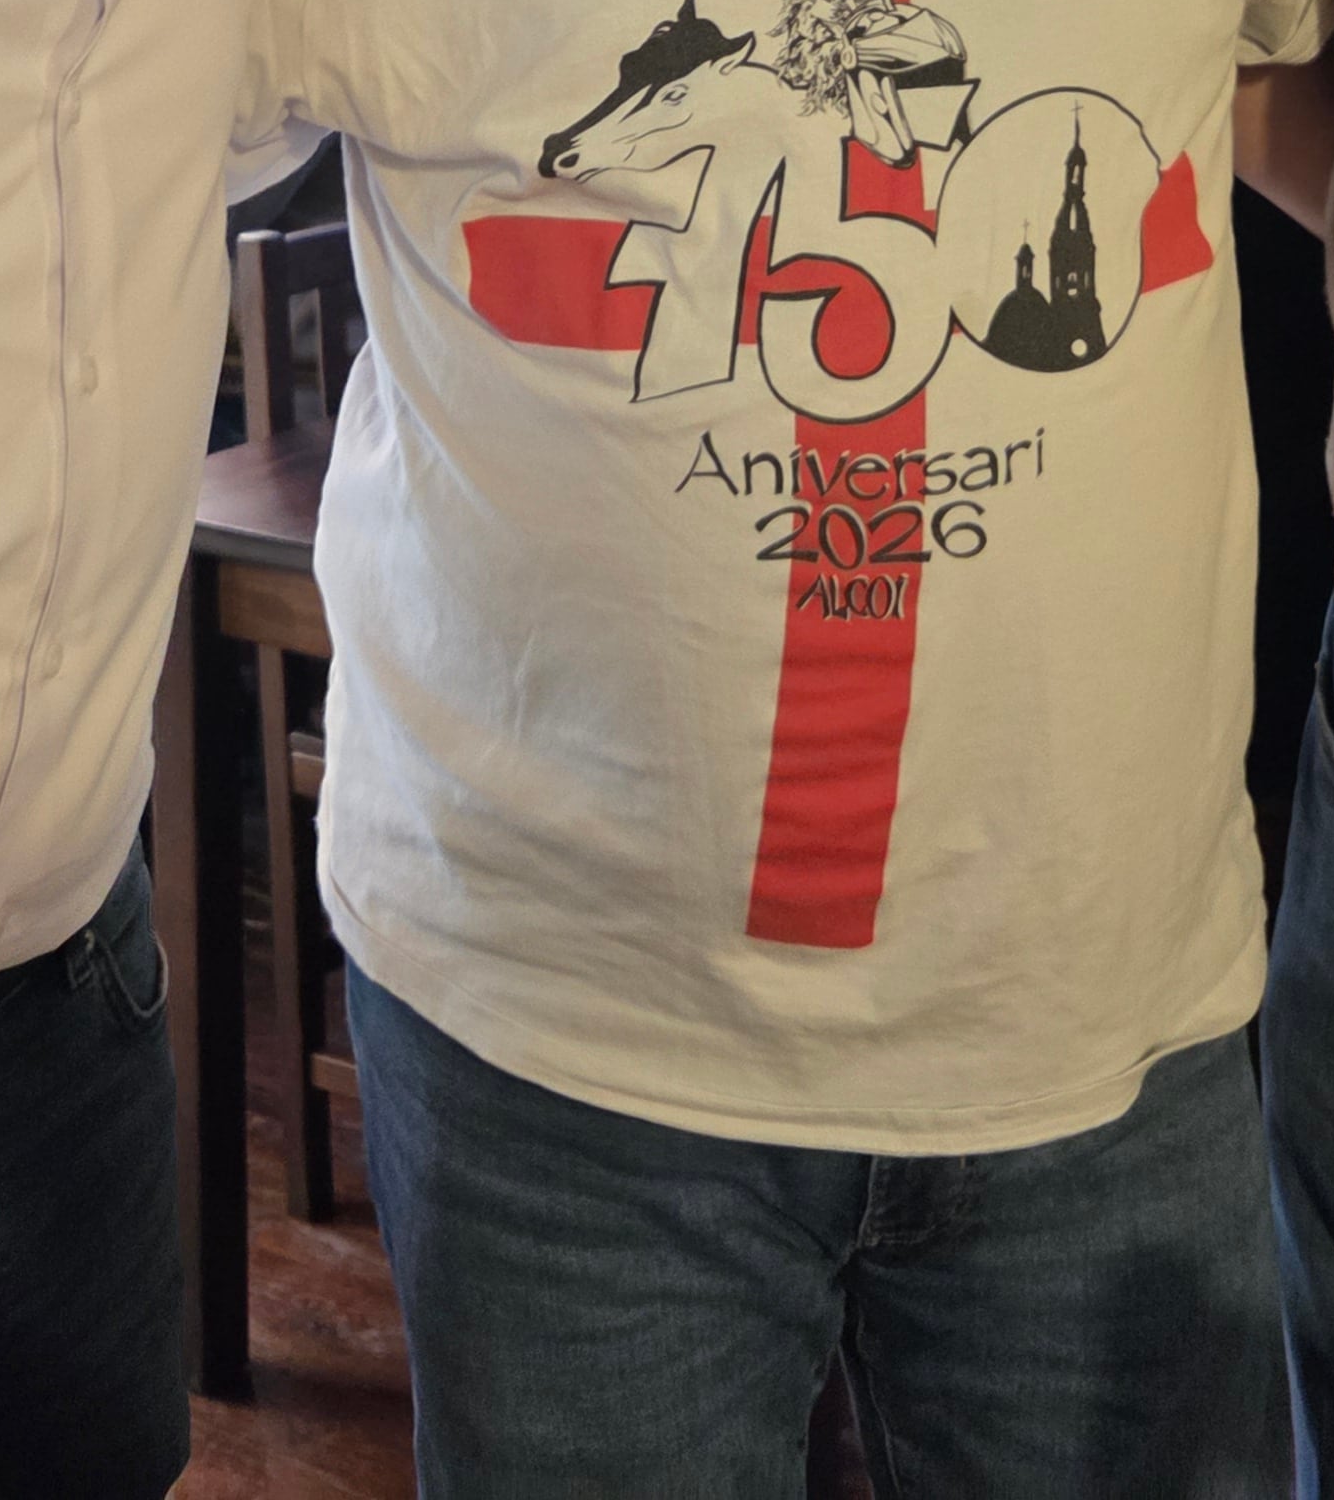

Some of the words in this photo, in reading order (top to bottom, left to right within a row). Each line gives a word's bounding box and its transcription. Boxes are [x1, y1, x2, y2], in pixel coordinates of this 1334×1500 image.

[674, 426, 1046, 501] Aniversari
[754, 500, 988, 571] 2026
[795, 573, 910, 623] ALCOI
